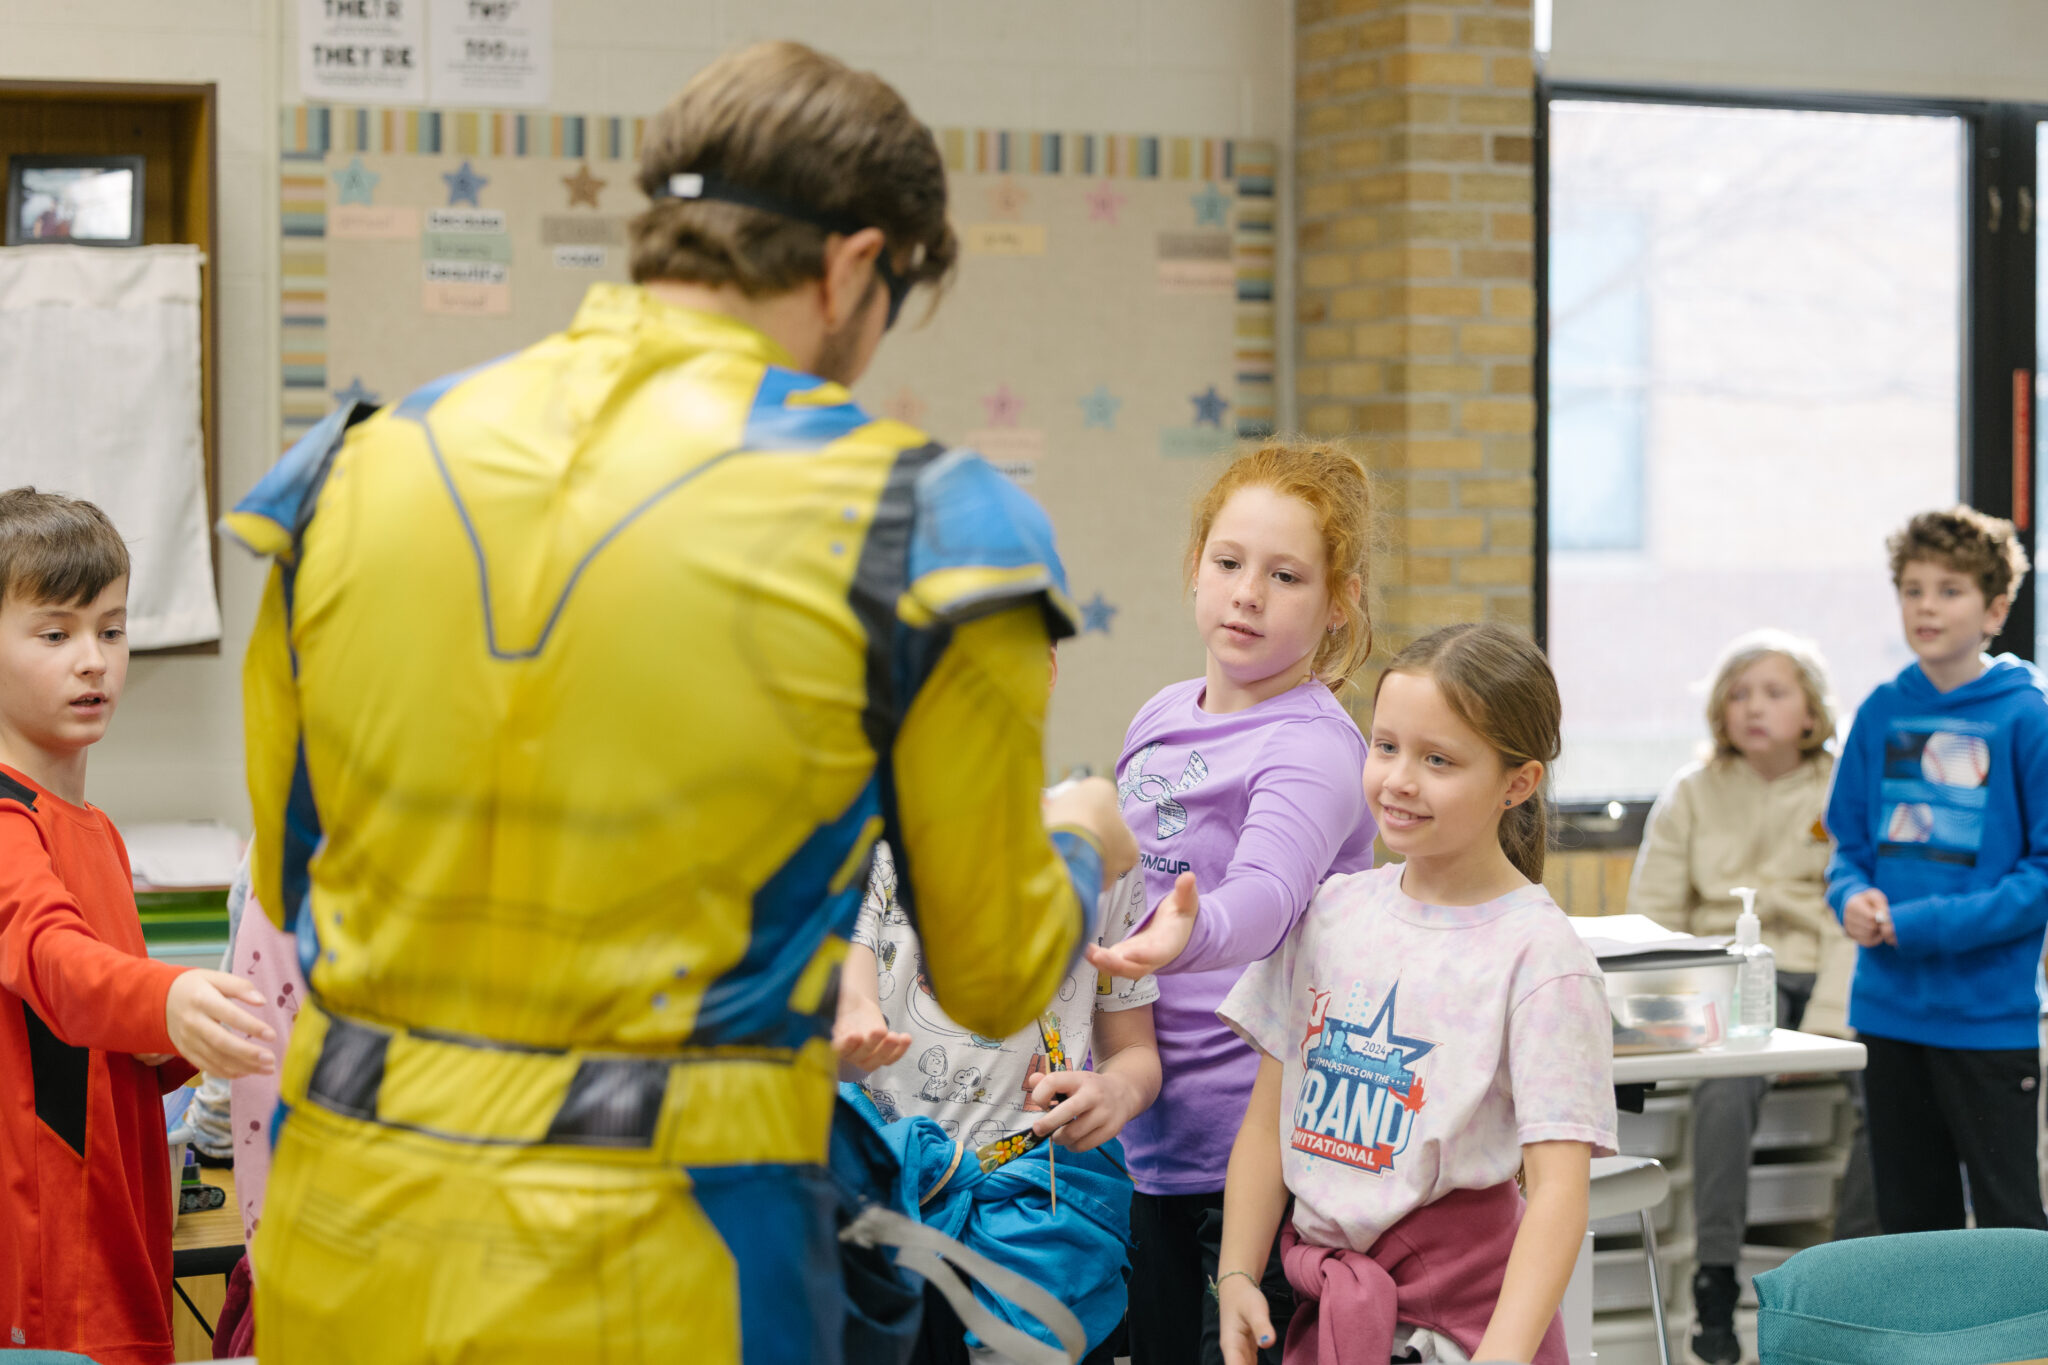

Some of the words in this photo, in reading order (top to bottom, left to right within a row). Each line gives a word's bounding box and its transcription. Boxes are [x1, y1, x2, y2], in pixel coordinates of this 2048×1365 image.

[1361, 1041, 1387, 1056] 2024
[1315, 1057, 1360, 1076] MNASTICS
[1359, 1069, 1375, 1081] ON
[1374, 1072, 1391, 1084] THE
[1297, 1068, 1414, 1155] RAND
